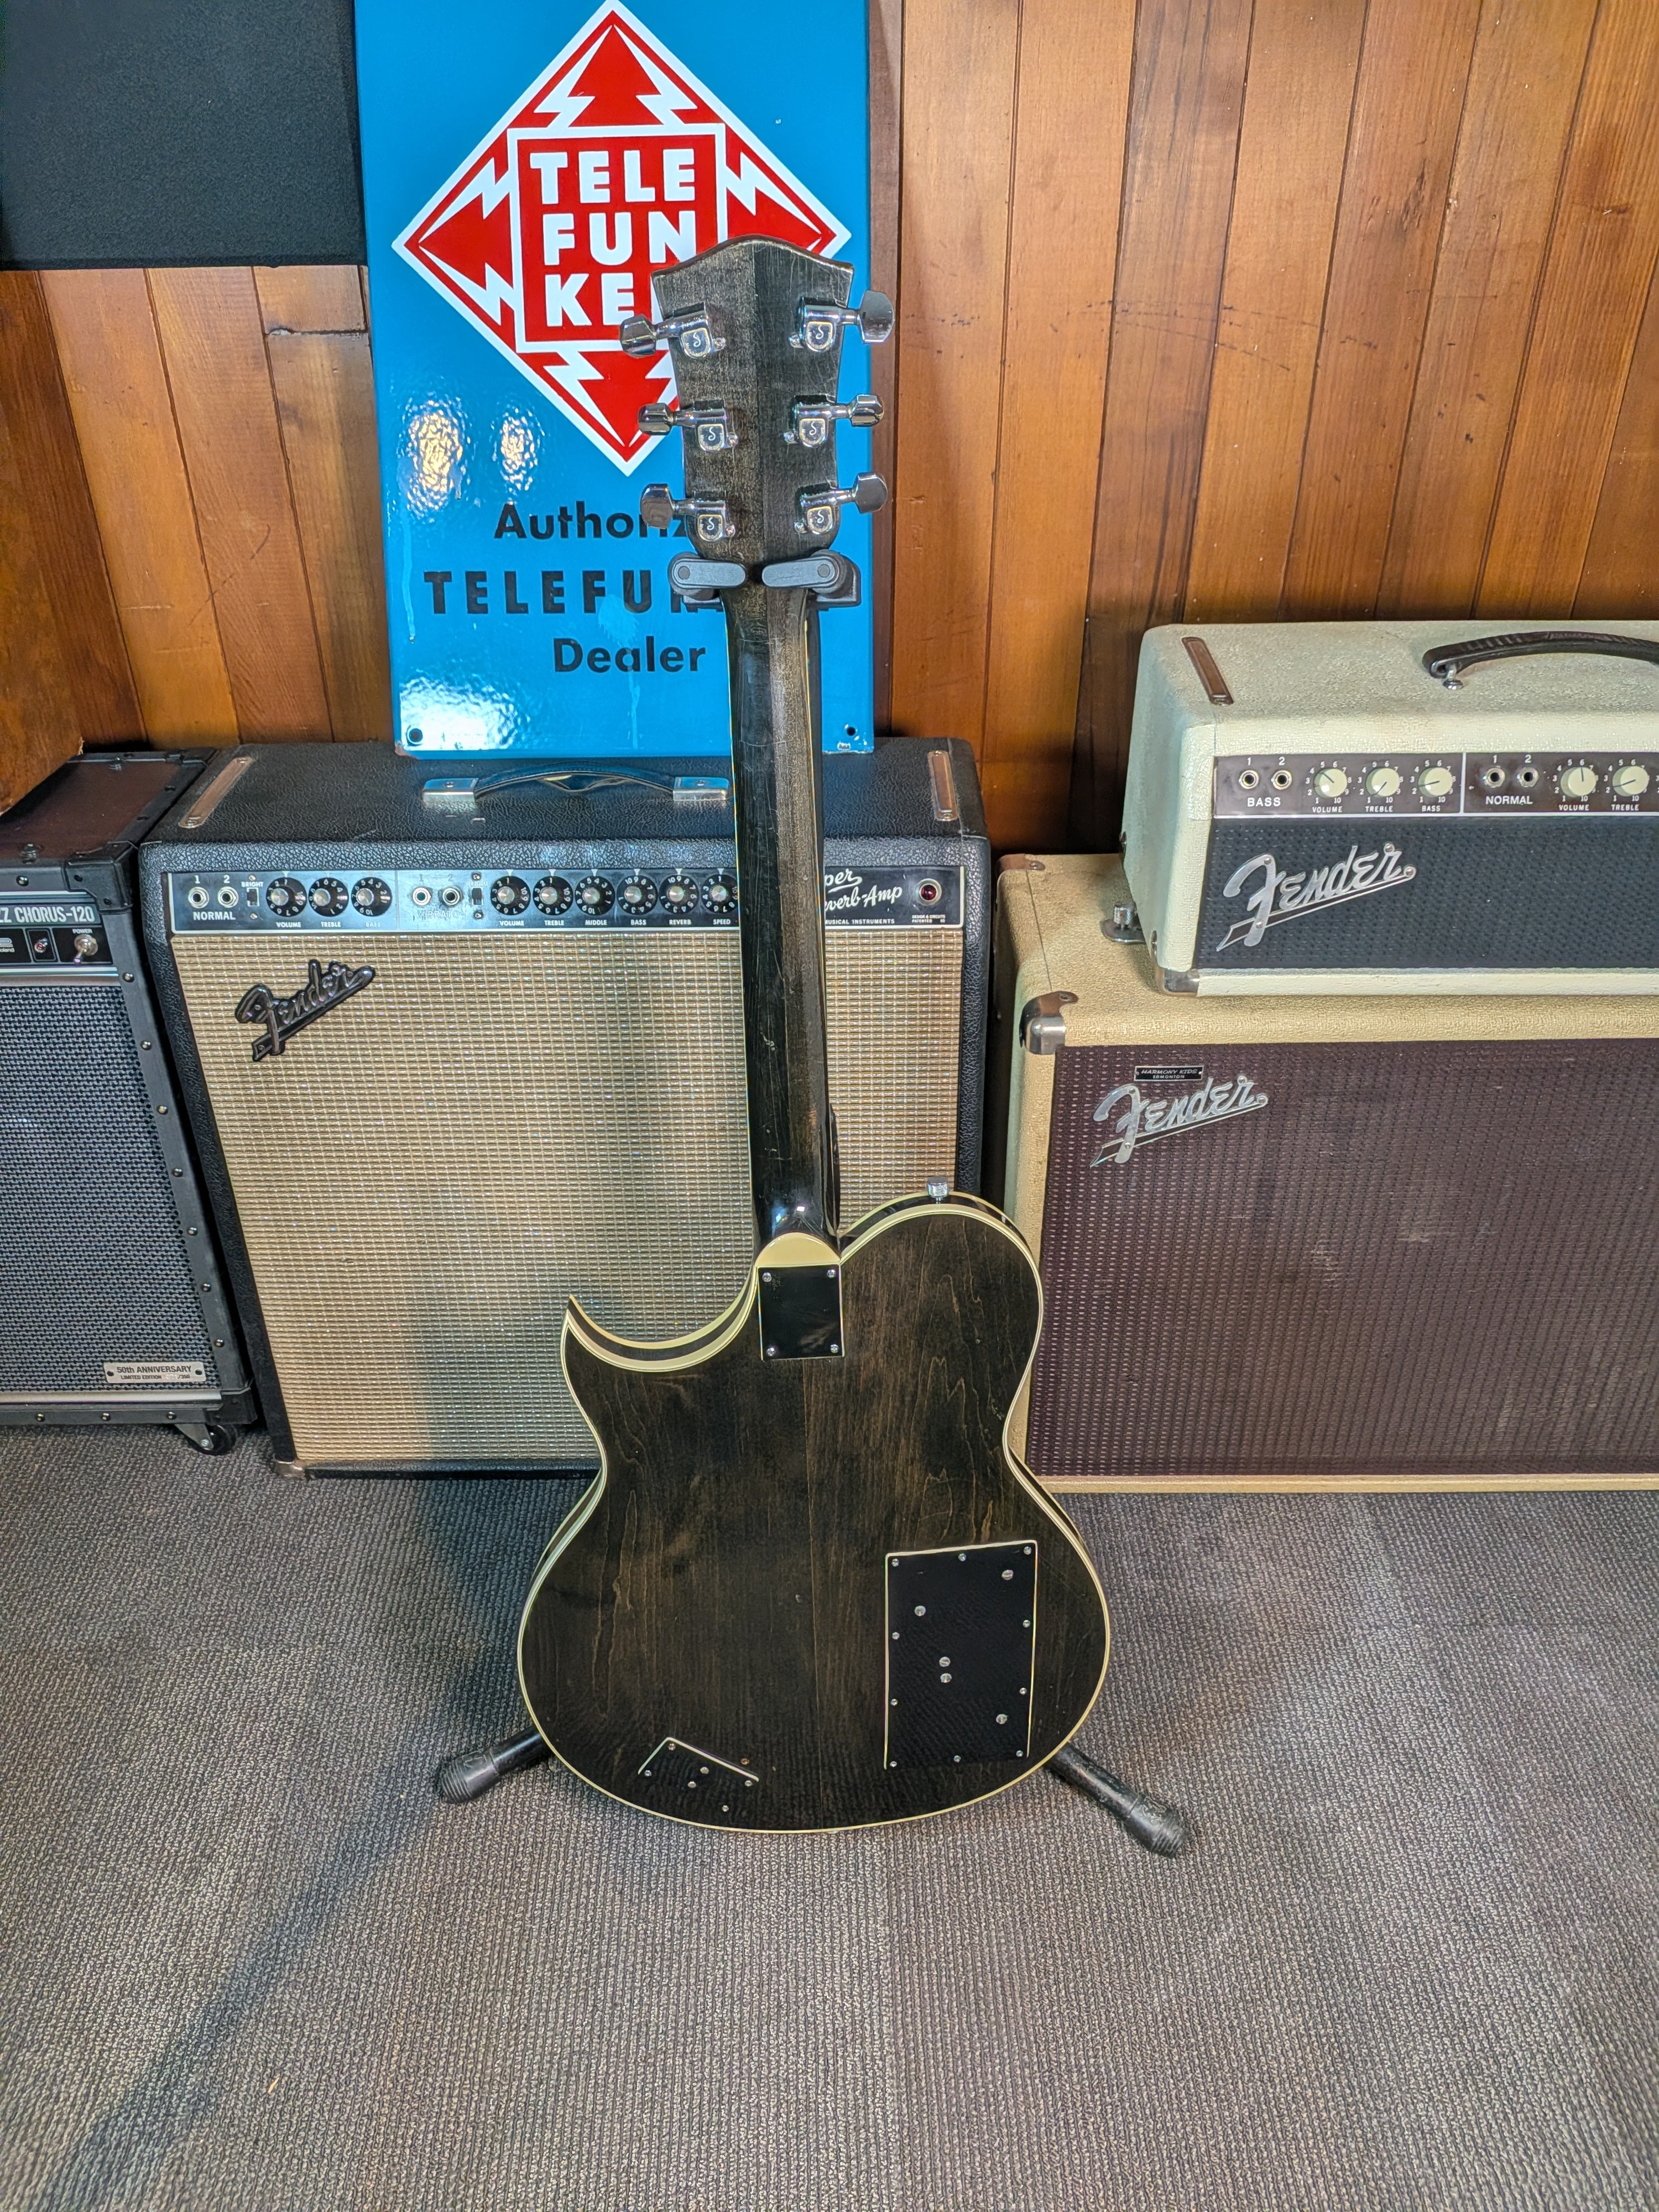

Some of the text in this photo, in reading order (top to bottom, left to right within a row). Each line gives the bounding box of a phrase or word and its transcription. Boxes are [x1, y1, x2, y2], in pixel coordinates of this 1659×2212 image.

[530, 148, 695, 205] TELE
[542, 210, 697, 266] FUN
[545, 273, 664, 327] KE
[553, 635, 706, 673] Dealer
[1248, 757, 1285, 765] 1 2
[1493, 754, 1531, 763] 1 2
[1248, 797, 1281, 807] BASS
[1485, 796, 1533, 805] NORMAL
[195, 875, 230, 884] 1 2
[825, 868, 862, 893] per
[825, 885, 902, 910] verb-Amp
[1217, 842, 1416, 952] Fender
[14, 906, 95, 923] CHORUS-120
[194, 911, 236, 921] NORMAL
[418, 910, 460, 919] VIBRATO
[235, 959, 375, 1061] Fender
[1089, 1074, 1269, 1168] Fender
